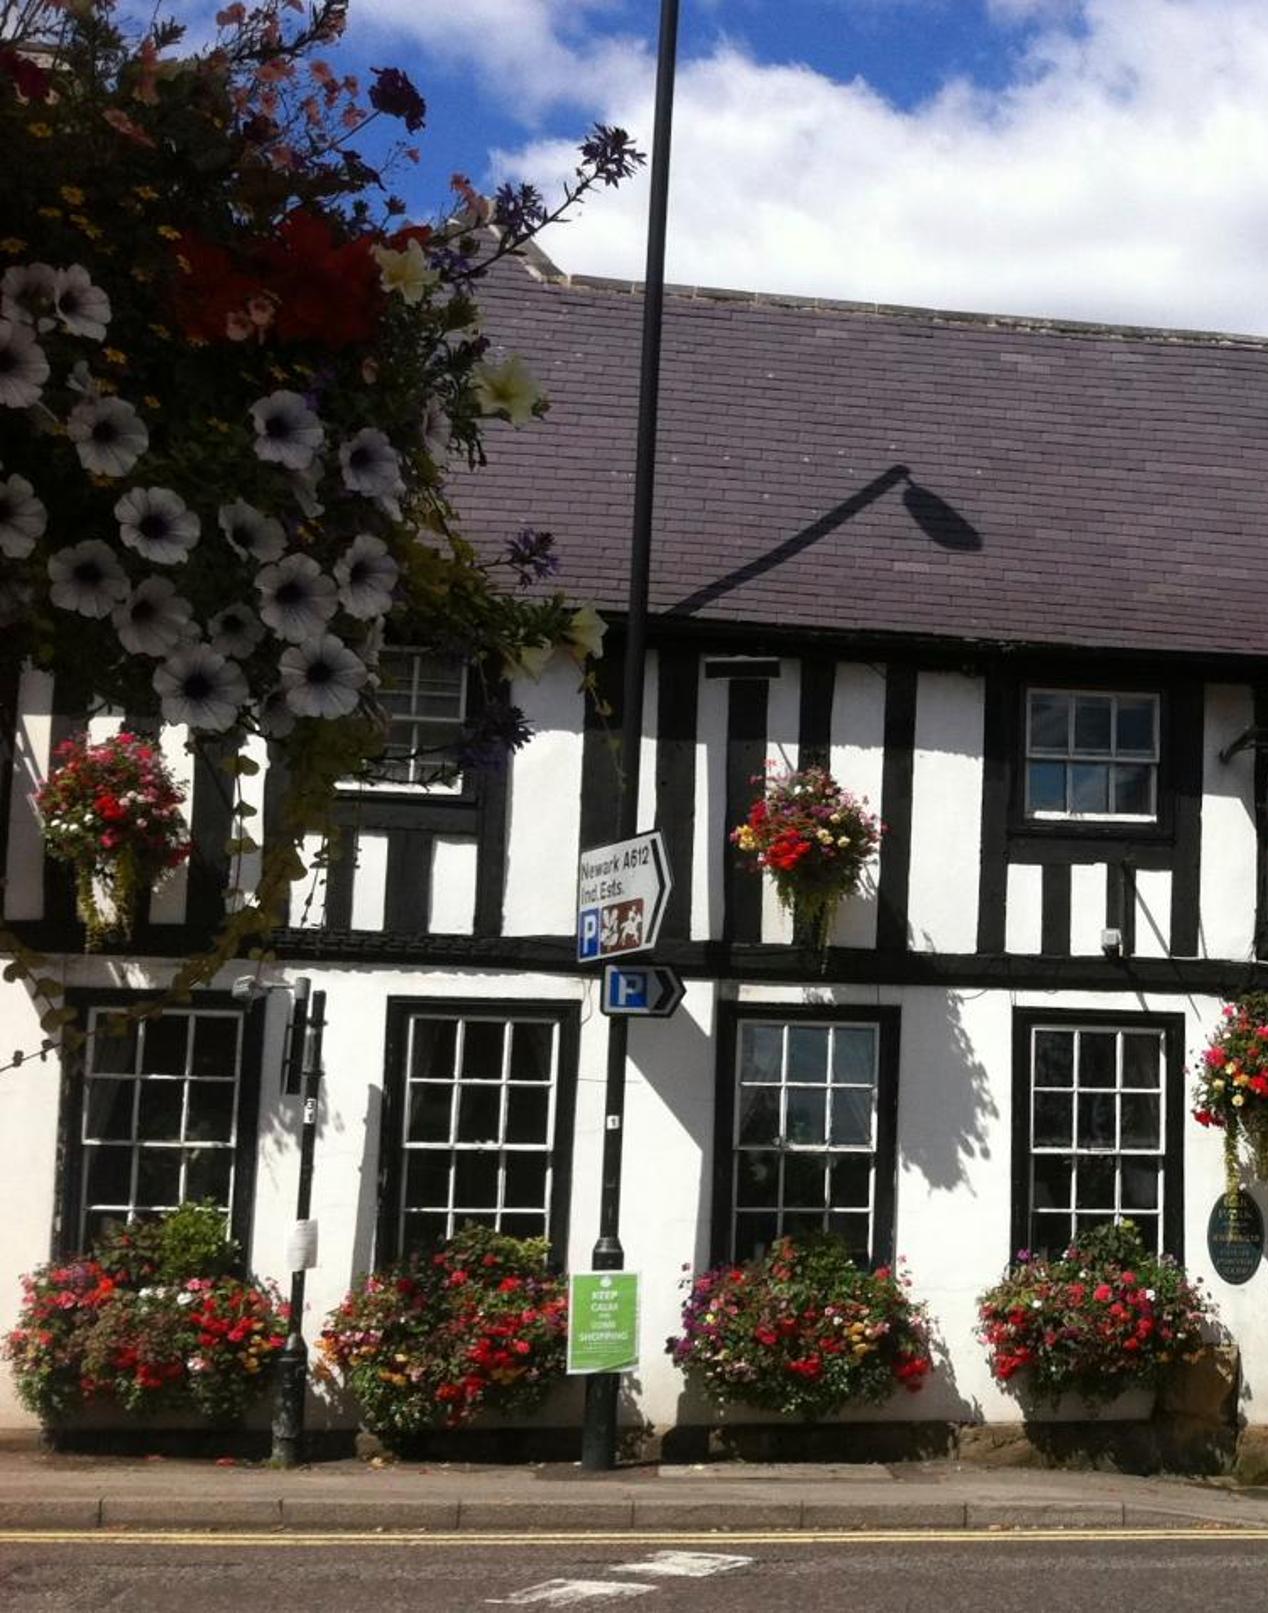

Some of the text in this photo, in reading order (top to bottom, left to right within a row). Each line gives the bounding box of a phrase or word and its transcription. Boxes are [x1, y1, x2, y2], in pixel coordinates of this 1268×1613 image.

[580, 845, 649, 881] Newark A612
[583, 914, 597, 953] P
[618, 973, 640, 1006] P
[592, 1290, 618, 1300] KEEP
[591, 1302, 618, 1312] CALM
[577, 1331, 629, 1342] SHOPPING
